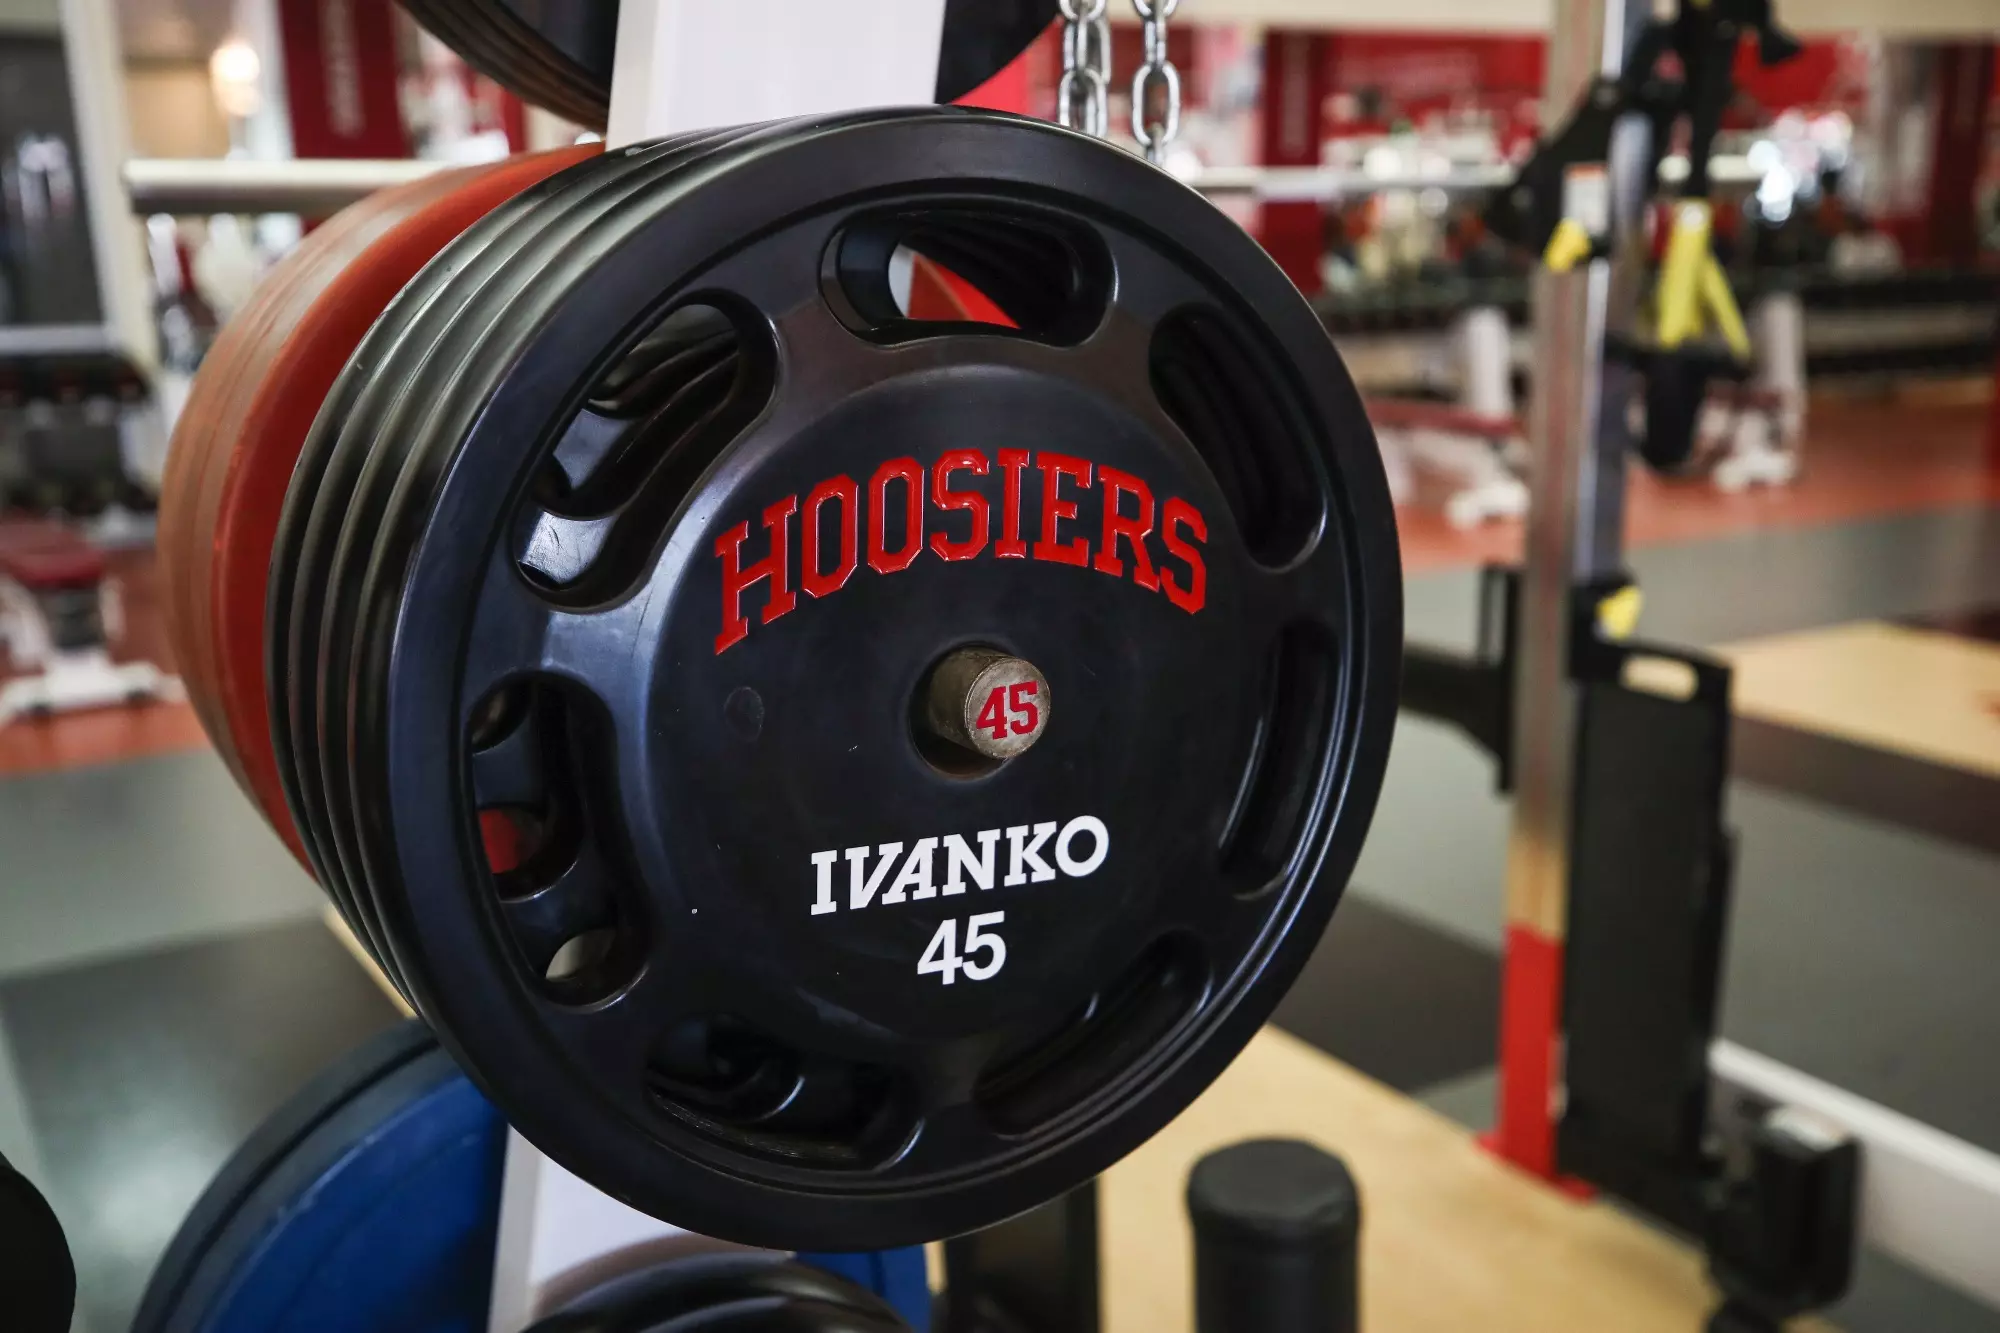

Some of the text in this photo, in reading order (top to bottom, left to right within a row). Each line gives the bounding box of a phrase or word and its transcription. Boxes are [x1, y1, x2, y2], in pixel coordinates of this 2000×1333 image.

[714, 448, 1208, 656] HOOSIERS
[976, 679, 1040, 741] 45
[811, 815, 1110, 916] IVANKO
[917, 910, 1007, 986] 45
